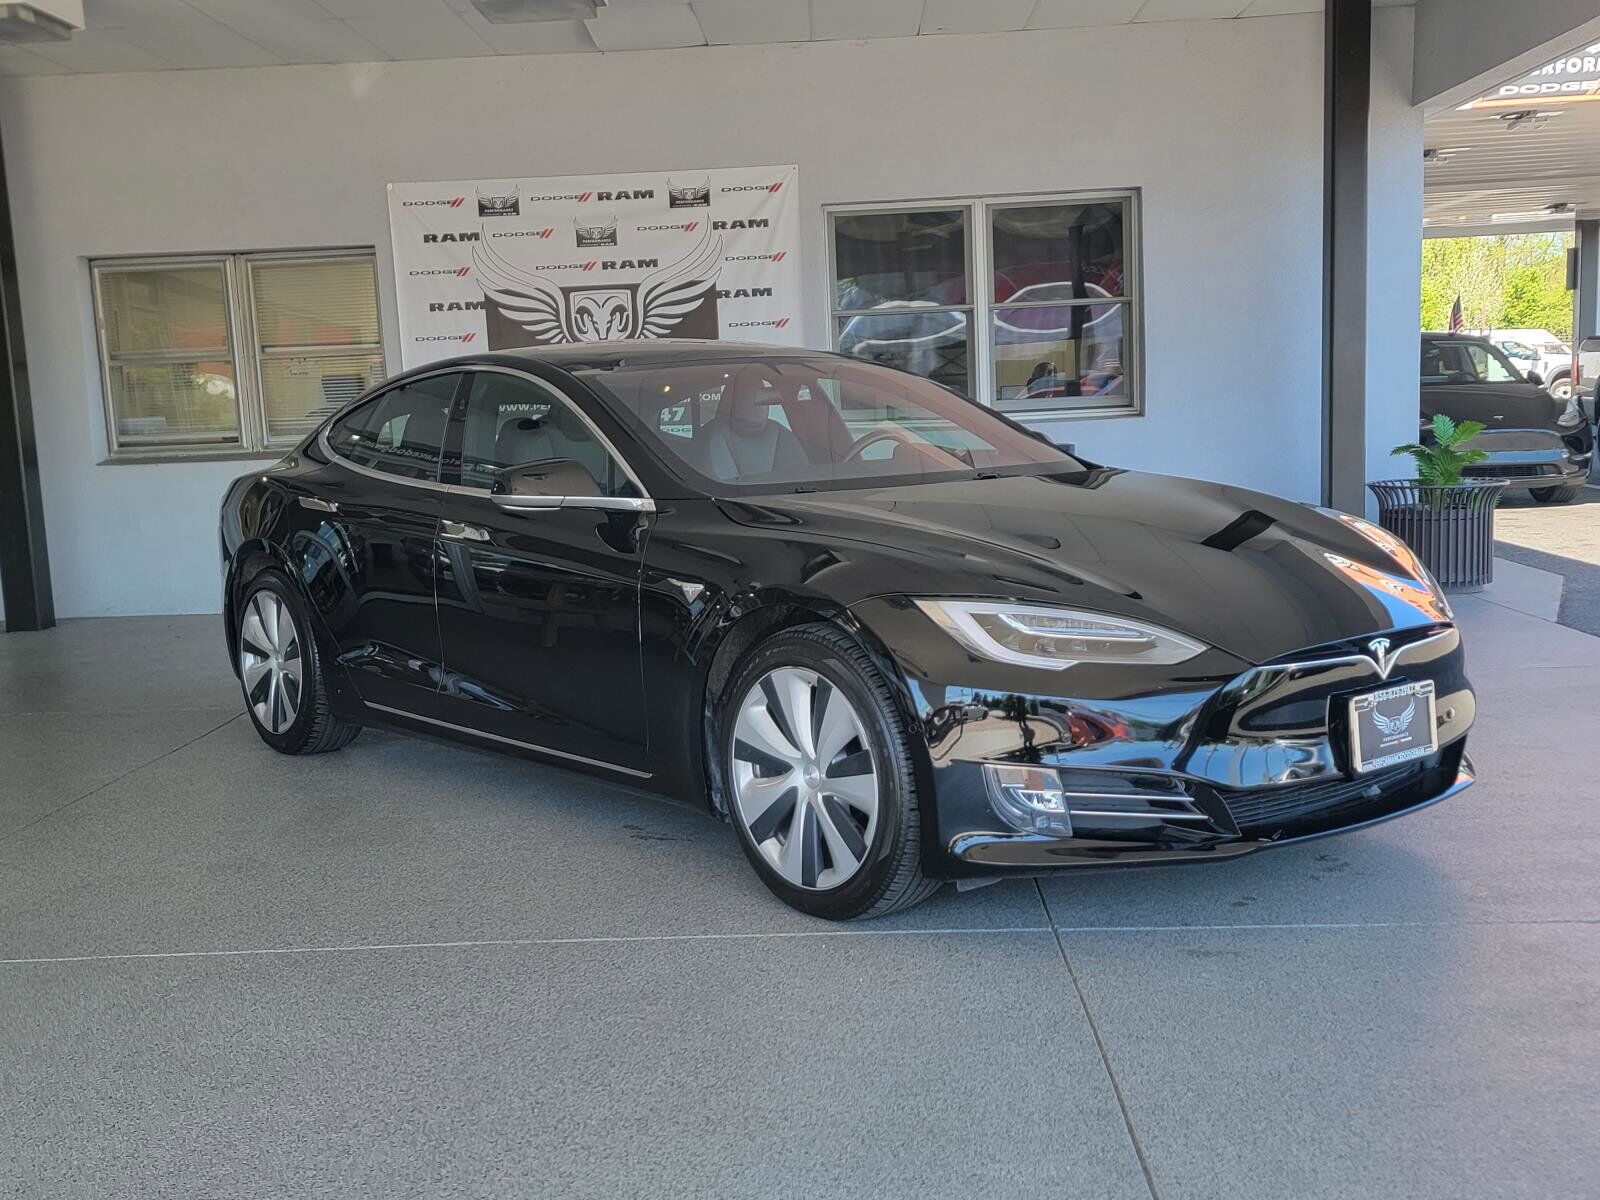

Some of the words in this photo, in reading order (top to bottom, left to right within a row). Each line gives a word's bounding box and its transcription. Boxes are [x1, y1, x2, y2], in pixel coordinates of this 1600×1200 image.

[1498, 81, 1599, 95] DODGE
[597, 189, 655, 201] RAM
[712, 218, 769, 230] RAM
[423, 232, 480, 243] RAM
[601, 258, 659, 270] RAM
[716, 287, 772, 299] RAM
[429, 301, 486, 312] RAM
